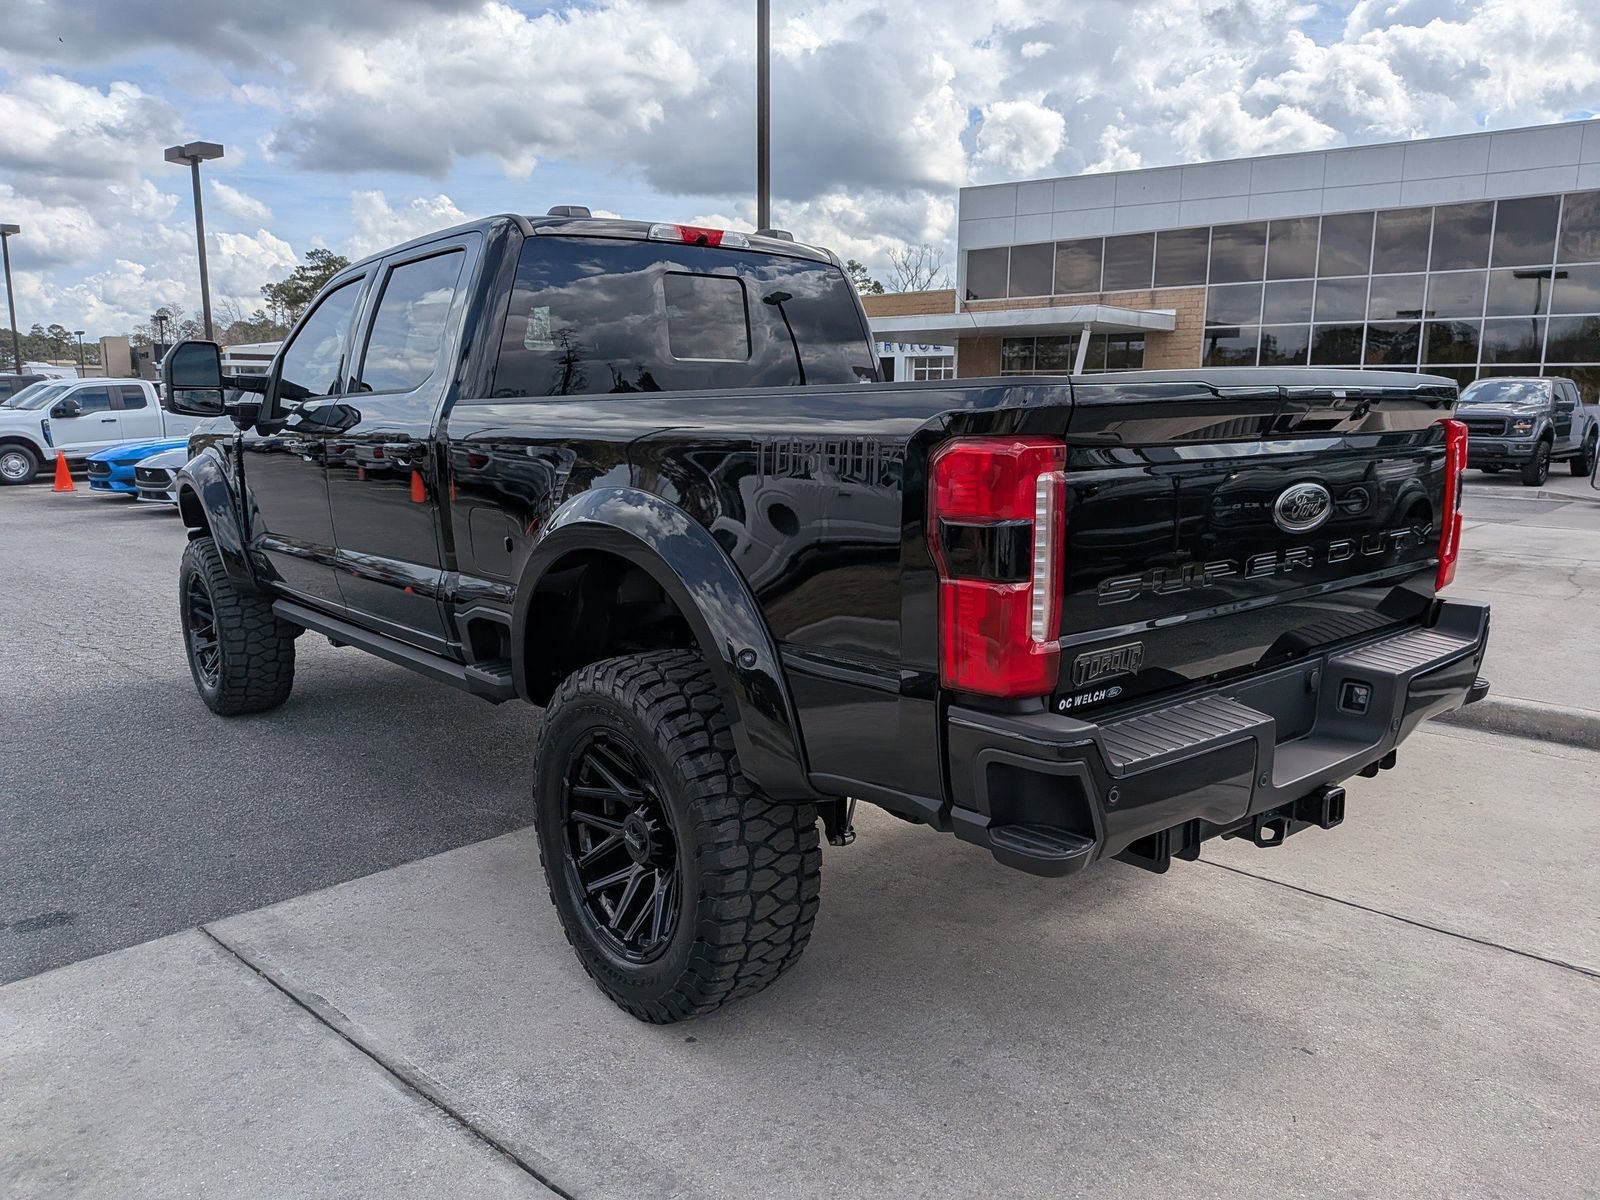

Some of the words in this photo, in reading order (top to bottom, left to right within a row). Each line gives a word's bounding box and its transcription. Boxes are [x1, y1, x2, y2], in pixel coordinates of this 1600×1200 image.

[1291, 492, 1325, 519] Ford
[1097, 545, 1314, 606] SUPER
[1328, 522, 1433, 564] DUTY
[1079, 644, 1142, 686] TORQUE
[1058, 697, 1073, 711] OC
[1073, 689, 1106, 707] WELCH
